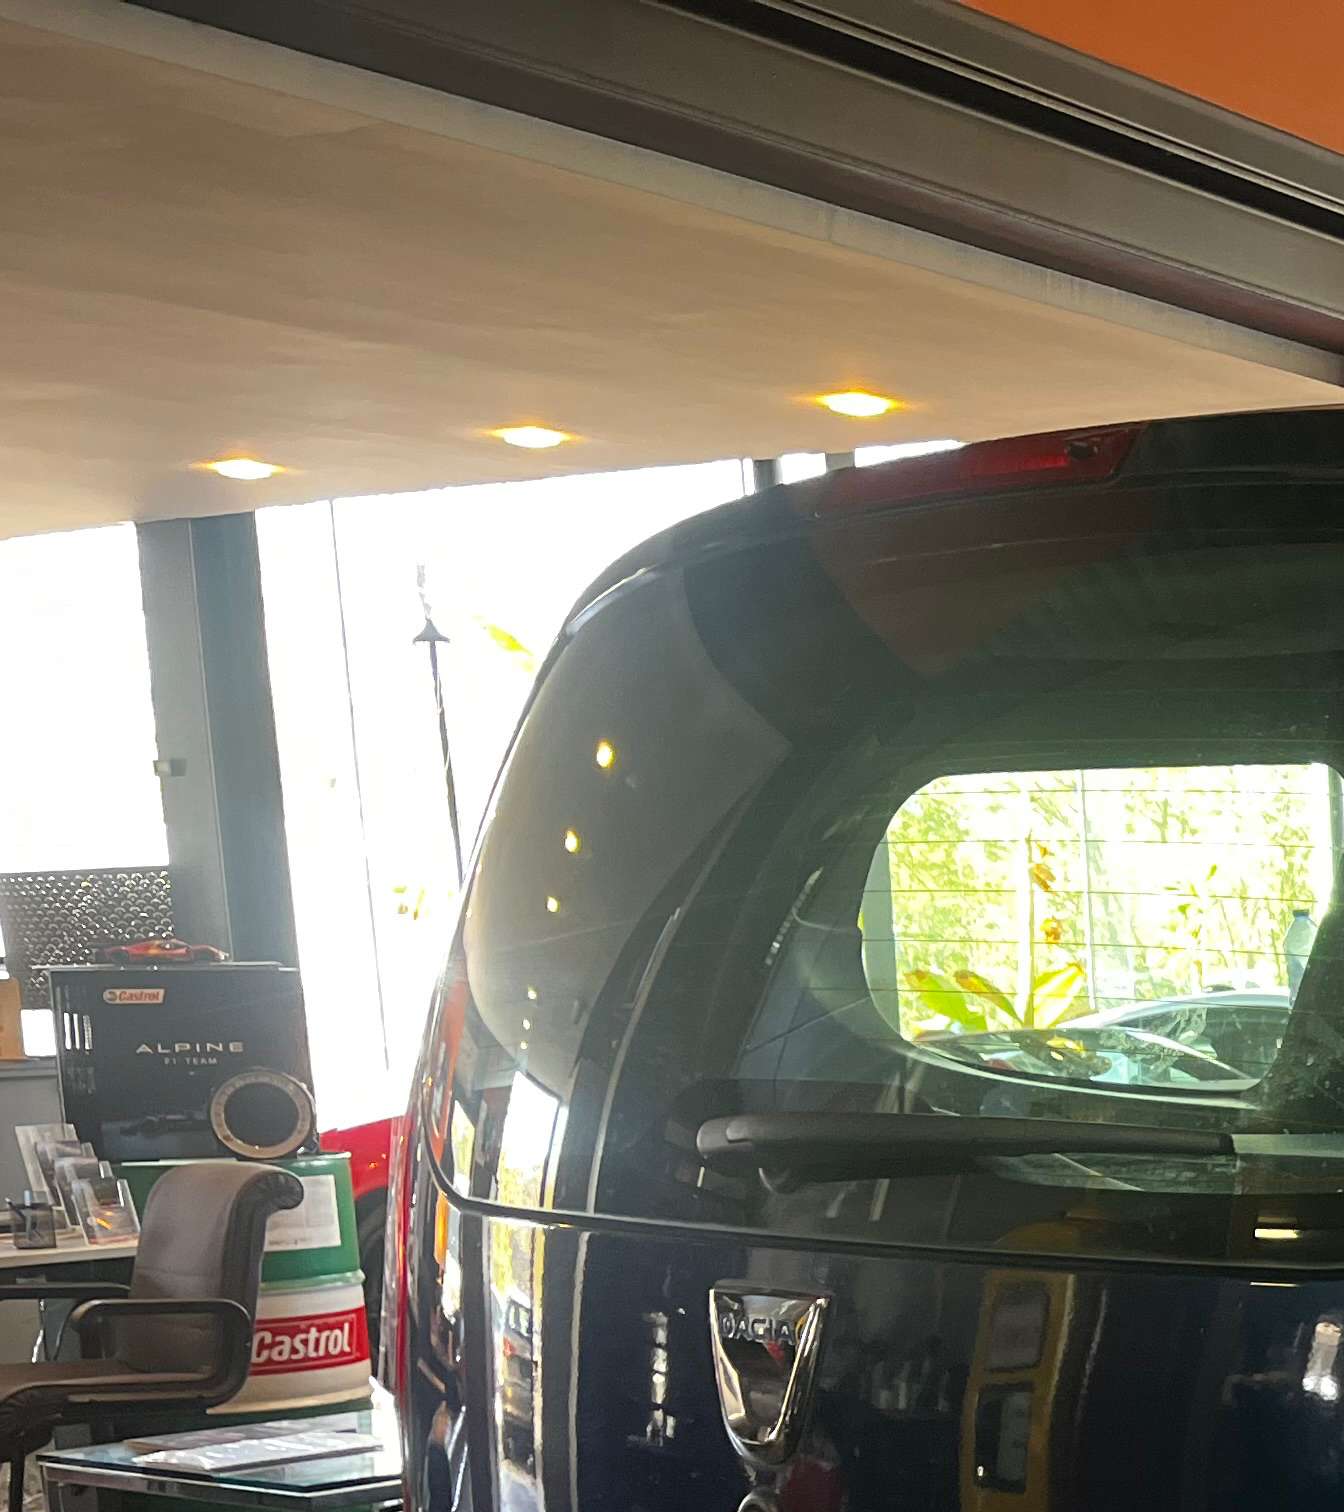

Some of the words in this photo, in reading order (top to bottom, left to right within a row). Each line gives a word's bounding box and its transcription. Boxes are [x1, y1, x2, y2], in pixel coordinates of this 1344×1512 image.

[118, 990, 160, 1001] Castrol
[136, 1042, 244, 1054] ALPINE
[185, 1057, 217, 1065] TEAM
[721, 1313, 795, 1345] DACIA
[251, 1322, 351, 1363] Castrol
